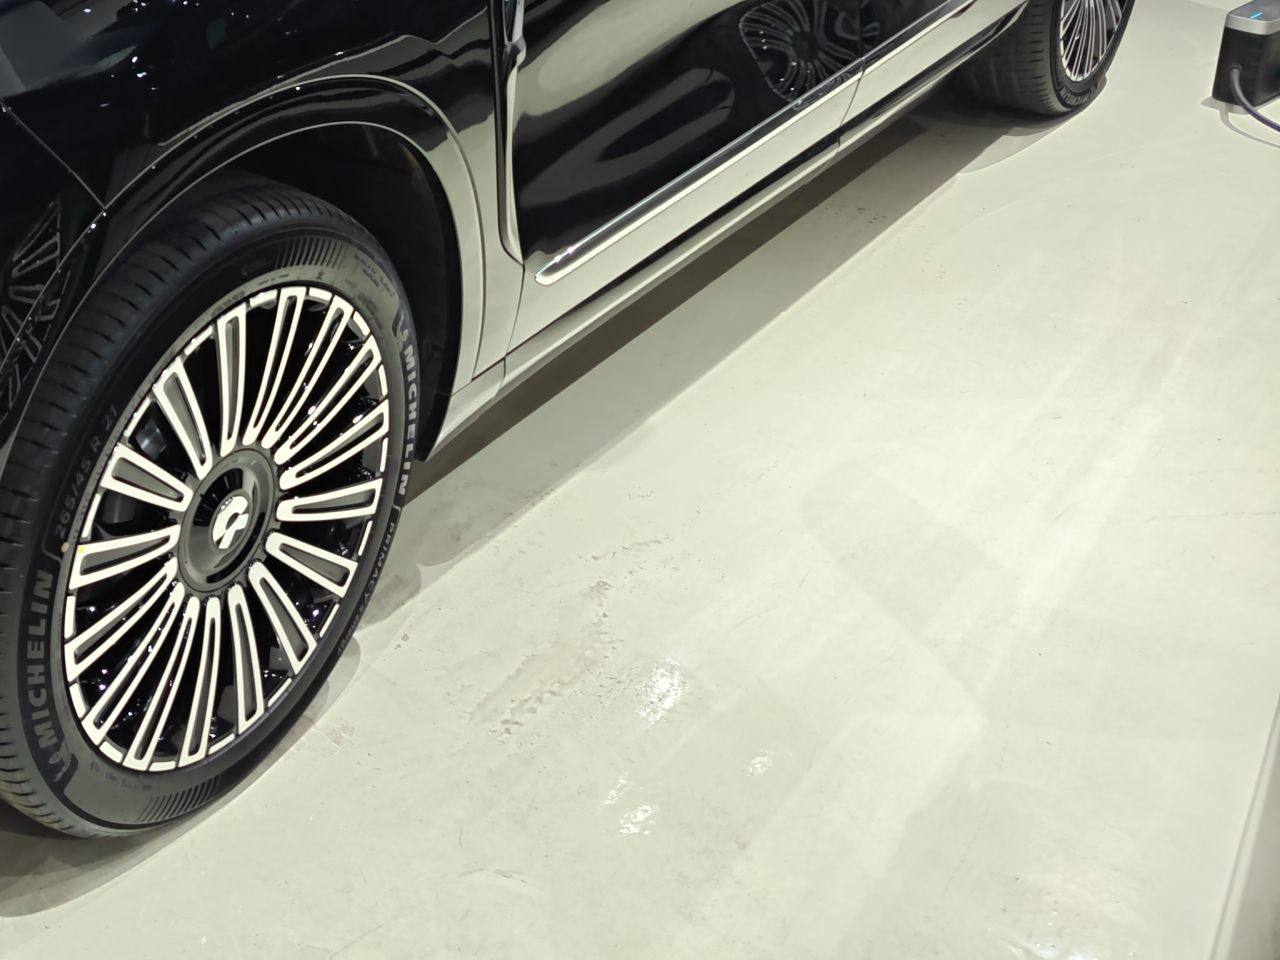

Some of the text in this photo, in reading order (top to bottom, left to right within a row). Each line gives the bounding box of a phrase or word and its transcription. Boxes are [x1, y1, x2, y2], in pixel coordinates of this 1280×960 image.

[398, 344, 417, 496] MICHELIN
[55, 458, 91, 539] 265/45
[26, 569, 55, 750] MICHELIN
